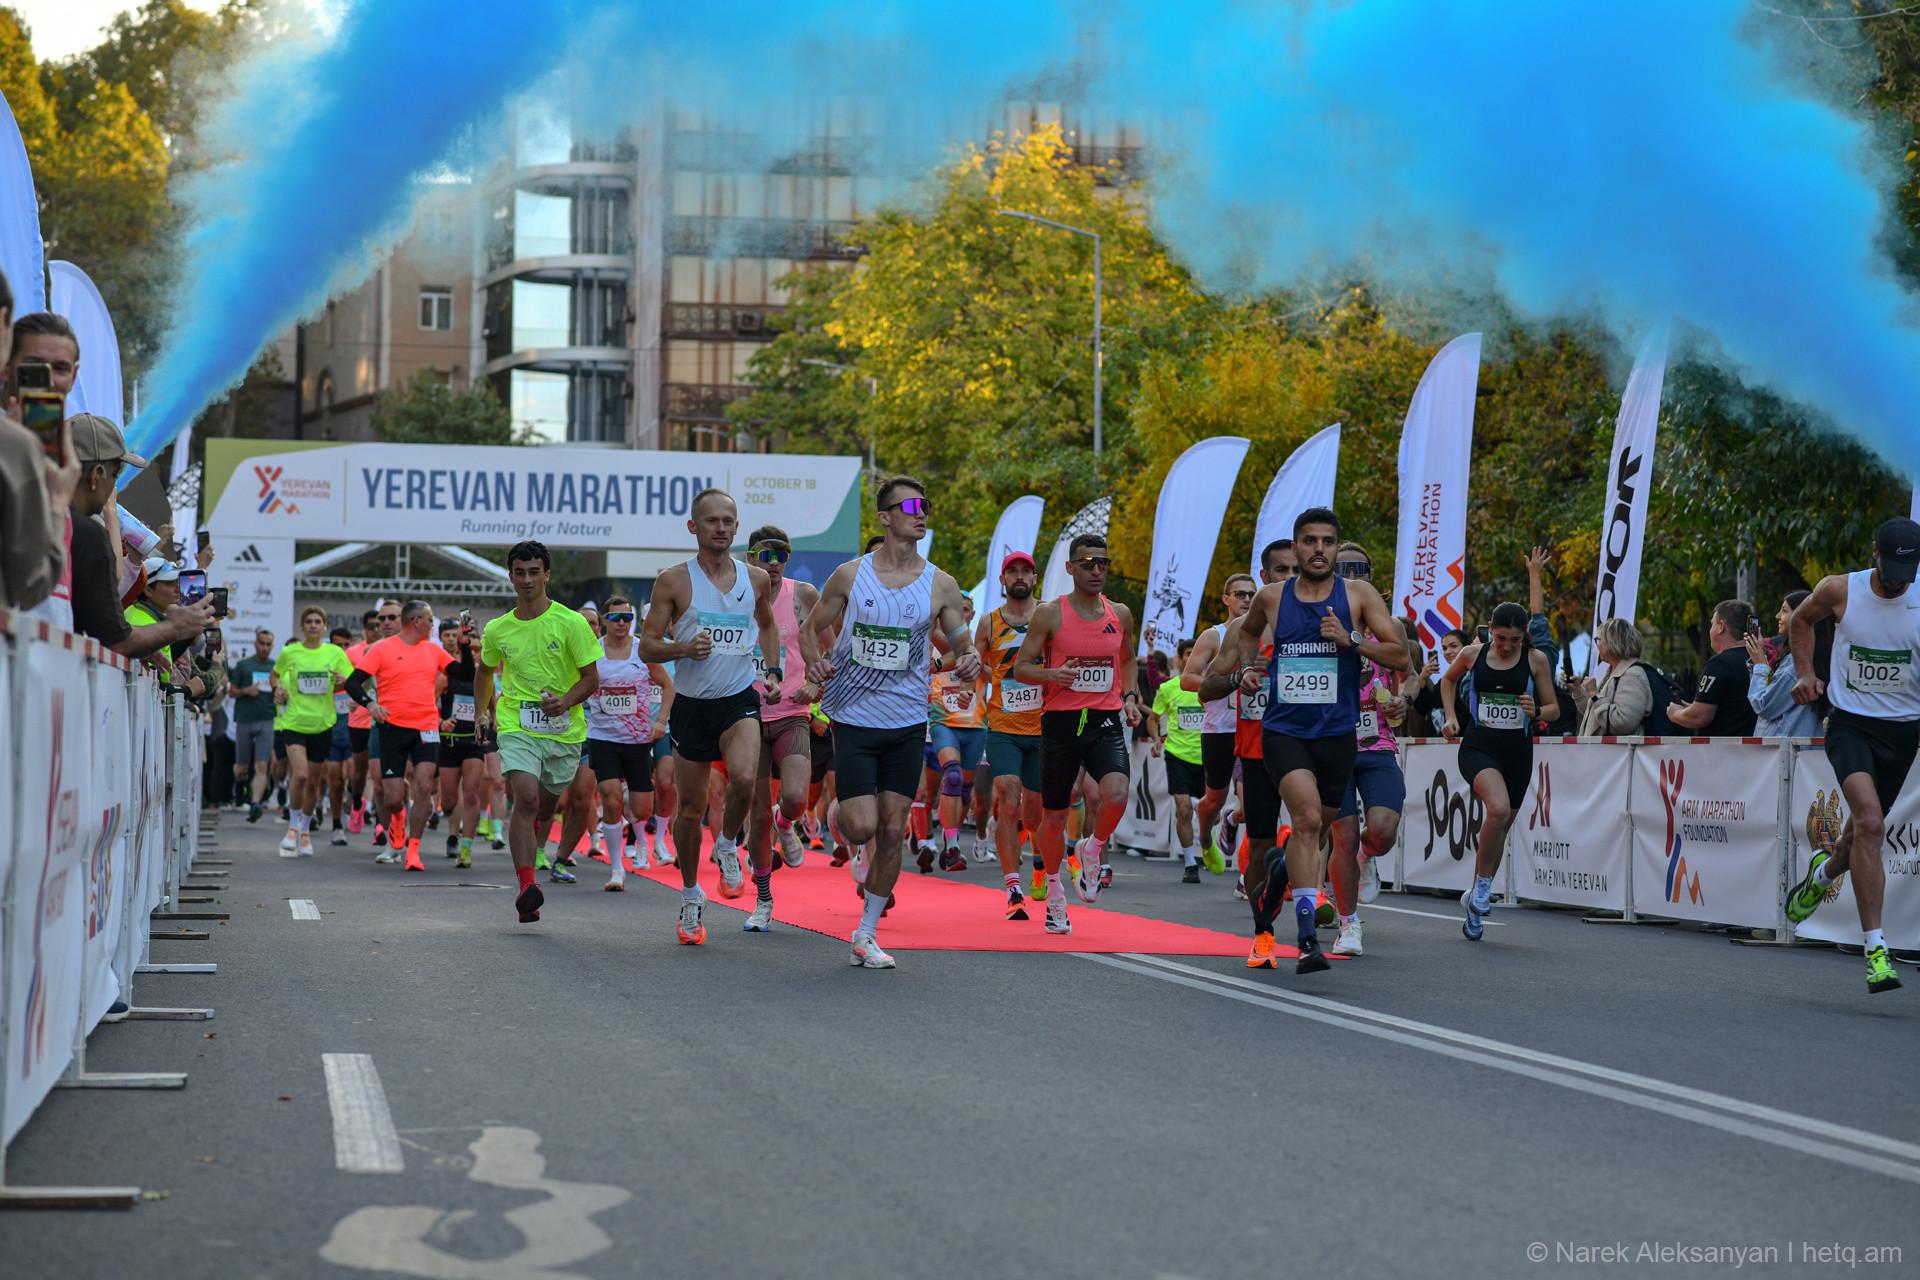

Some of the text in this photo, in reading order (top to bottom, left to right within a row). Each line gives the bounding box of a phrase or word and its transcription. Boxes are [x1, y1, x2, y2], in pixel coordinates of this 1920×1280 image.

[281, 479, 331, 489] YEREVAN
[362, 467, 516, 512] YEREVAN
[744, 477, 816, 490] OCTOBER 18
[281, 489, 331, 499] MARATHON
[743, 493, 775, 504] 2026
[460, 518, 612, 538] Running for Nature
[1412, 484, 1430, 598] YEREVAN
[1425, 483, 1442, 596] MARATHON
[861, 640, 899, 659] 1432
[1858, 663, 1900, 681] 1002
[304, 679, 323, 688] 1317
[1284, 675, 1329, 690] 2499
[1699, 675, 1716, 693] 97
[605, 697, 631, 707] 4016
[1007, 688, 1038, 704] 2487
[1248, 694, 1268, 708] 20
[456, 704, 475, 714] 239
[1486, 706, 1518, 720] 1003
[530, 711, 549, 724] 114
[1182, 714, 1204, 724] 1007
[1682, 800, 1746, 821] ARM MARATHON
[1683, 824, 1728, 843] FOUNDATION
[1533, 840, 1570, 860] MARRIOTT
[1534, 867, 1608, 893] ARMENIA YEREVAN
